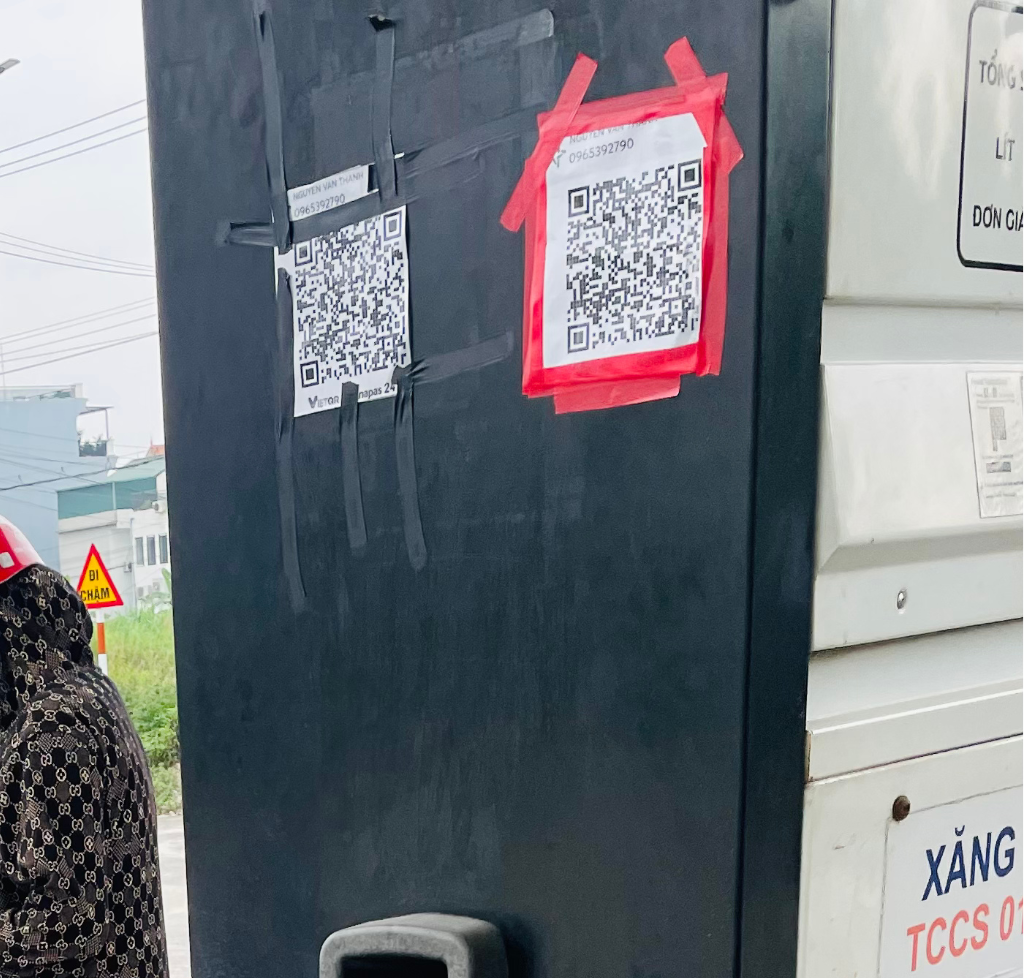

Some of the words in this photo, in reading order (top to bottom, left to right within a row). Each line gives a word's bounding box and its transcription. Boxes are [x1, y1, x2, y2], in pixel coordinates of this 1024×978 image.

[569, 137, 634, 163] 0965392790
[995, 132, 1016, 161] LÍT
[293, 186, 321, 200] NGUYEN
[323, 179, 336, 190] VAN
[339, 172, 363, 185] THANH
[294, 193, 345, 217] 0965392790
[972, 203, 1002, 229] ĐƠN
[358, 386, 382, 400] napas
[88, 569, 99, 582] ĐI
[80, 586, 110, 603] CHẬM
[922, 825, 1015, 901] XĂNG
[906, 903, 990, 972] TCCS
